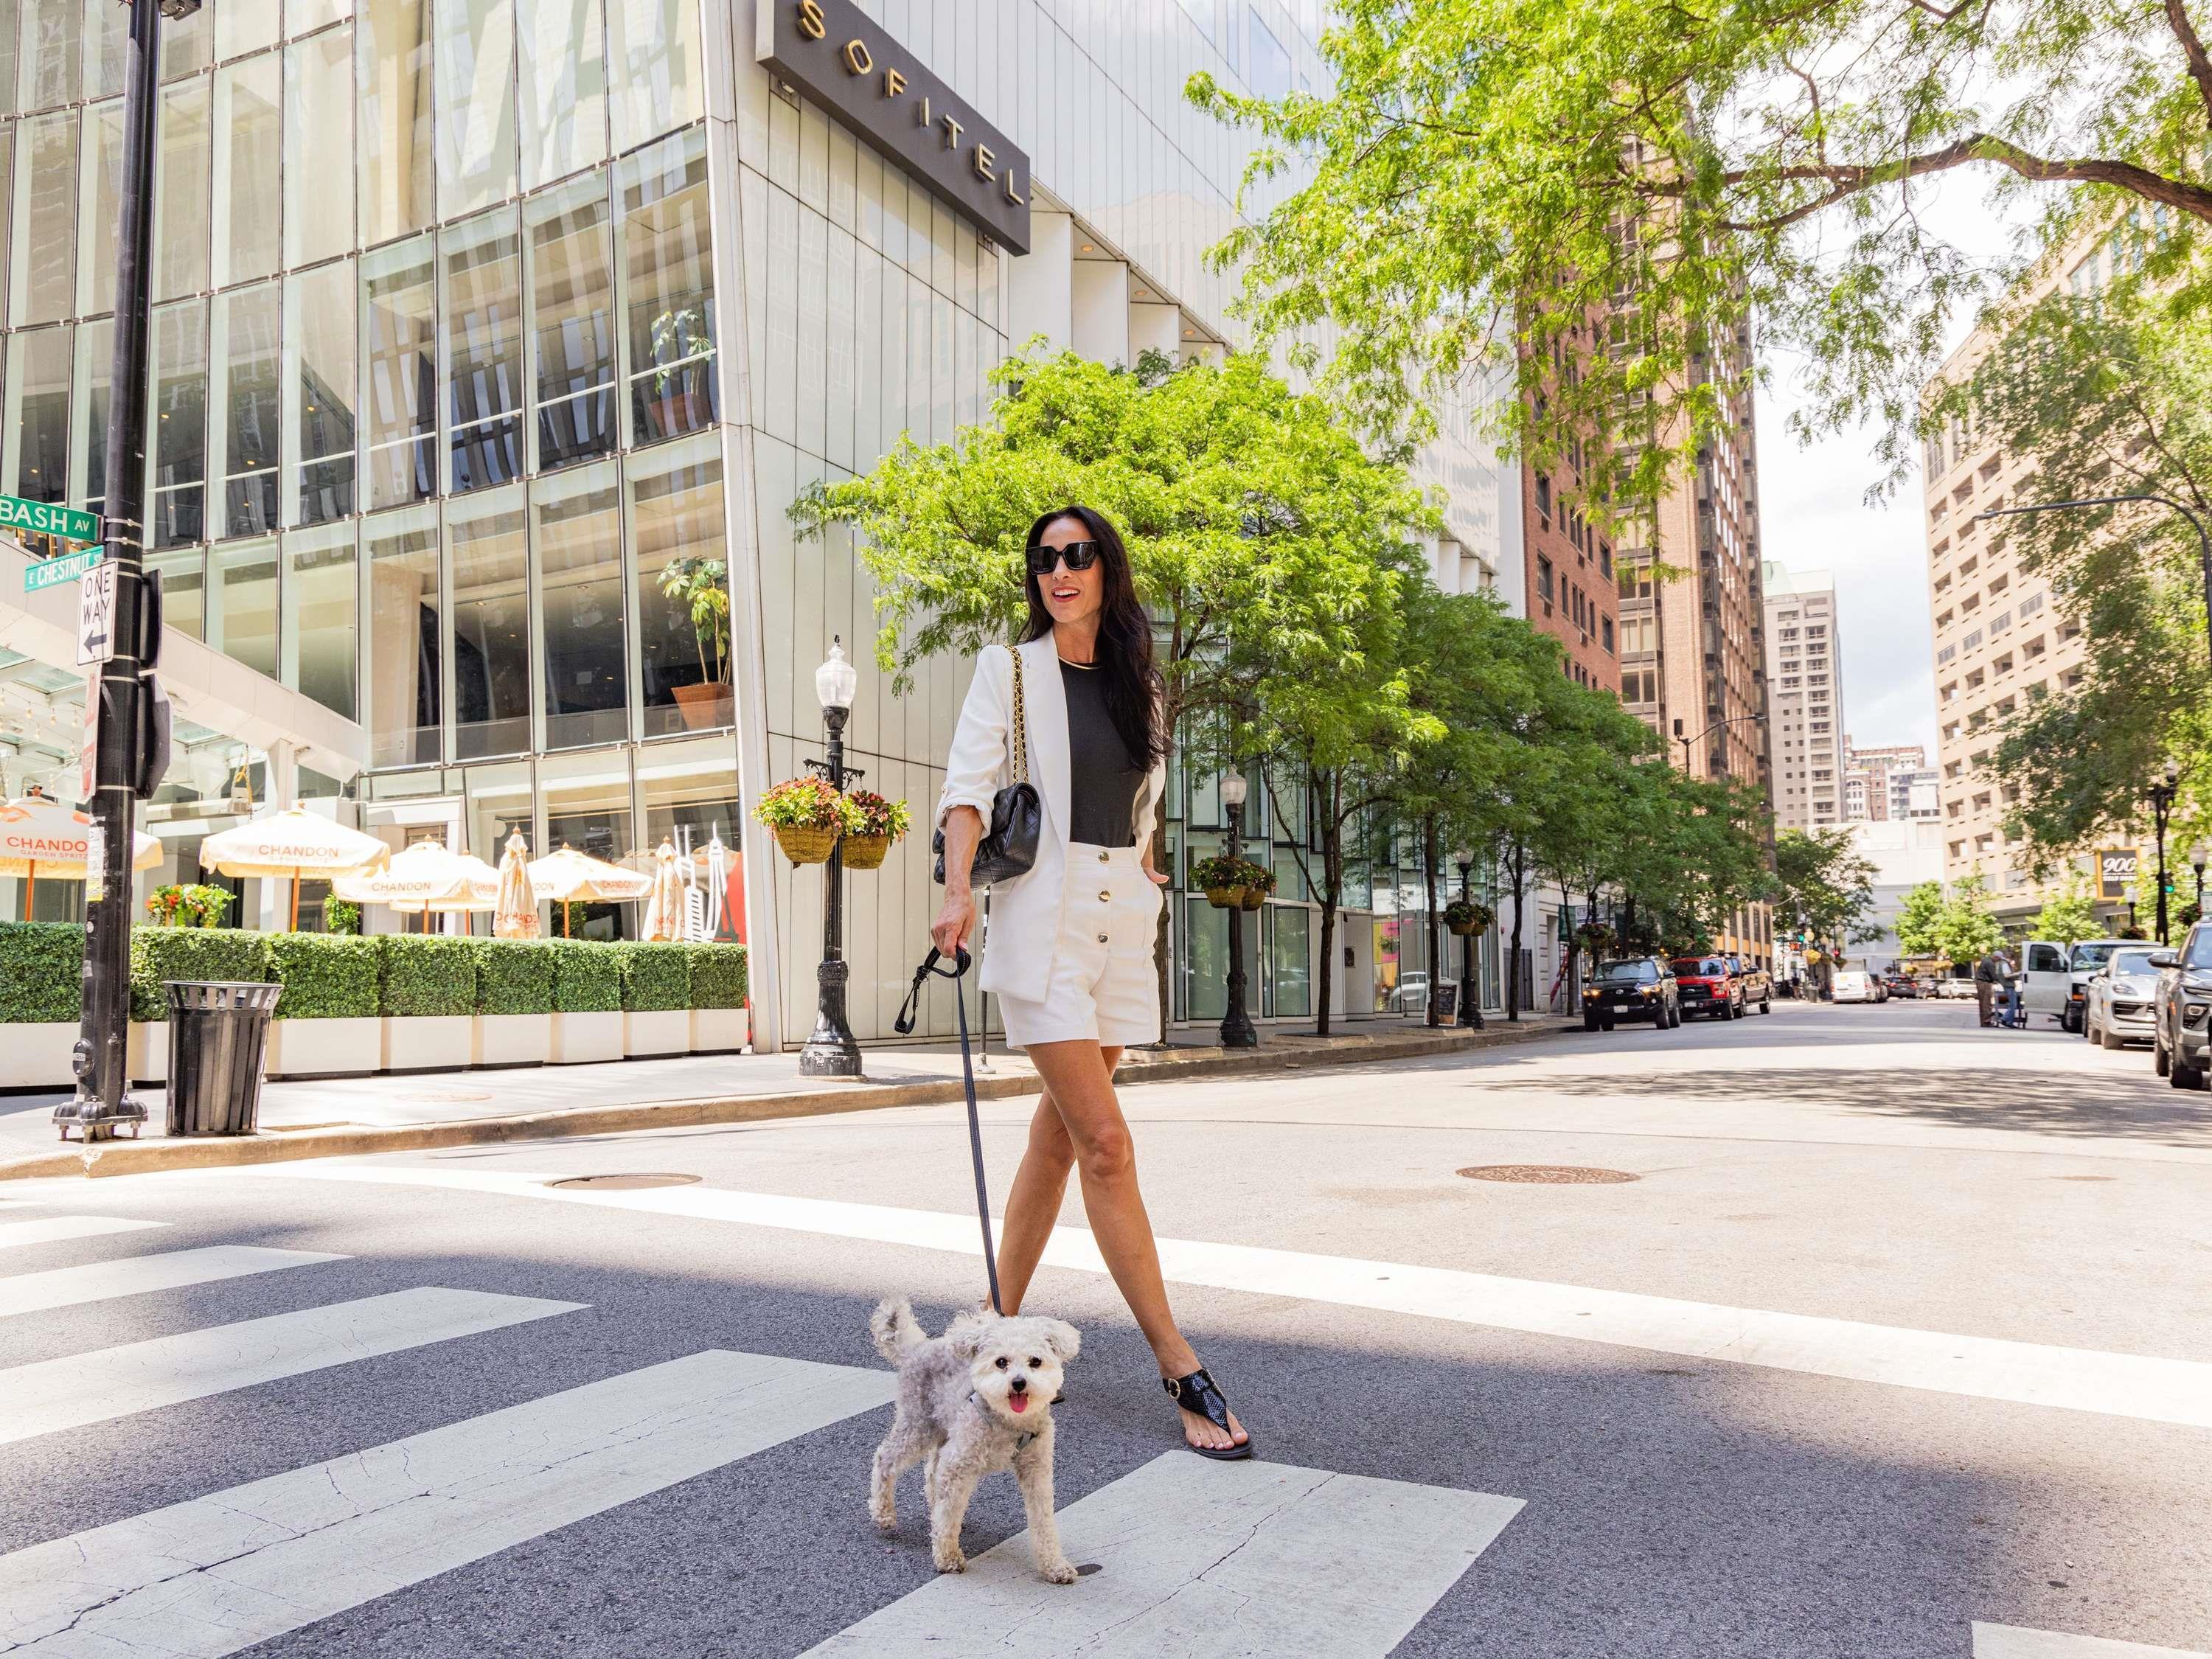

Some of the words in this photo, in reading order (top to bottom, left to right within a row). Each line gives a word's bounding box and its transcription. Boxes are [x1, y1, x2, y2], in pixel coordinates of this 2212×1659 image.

[798, 0, 1024, 206] SOFITEL
[74, 519, 90, 532] AV
[29, 572, 34, 585] E
[37, 552, 91, 585] CHESTNUT
[86, 571, 111, 598] ONE
[83, 598, 111, 626] WAY
[7, 836, 88, 852] CHANDO
[258, 844, 339, 858] CHANDON
[20, 849, 56, 858] GARDEN
[372, 882, 431, 891] CHANDON
